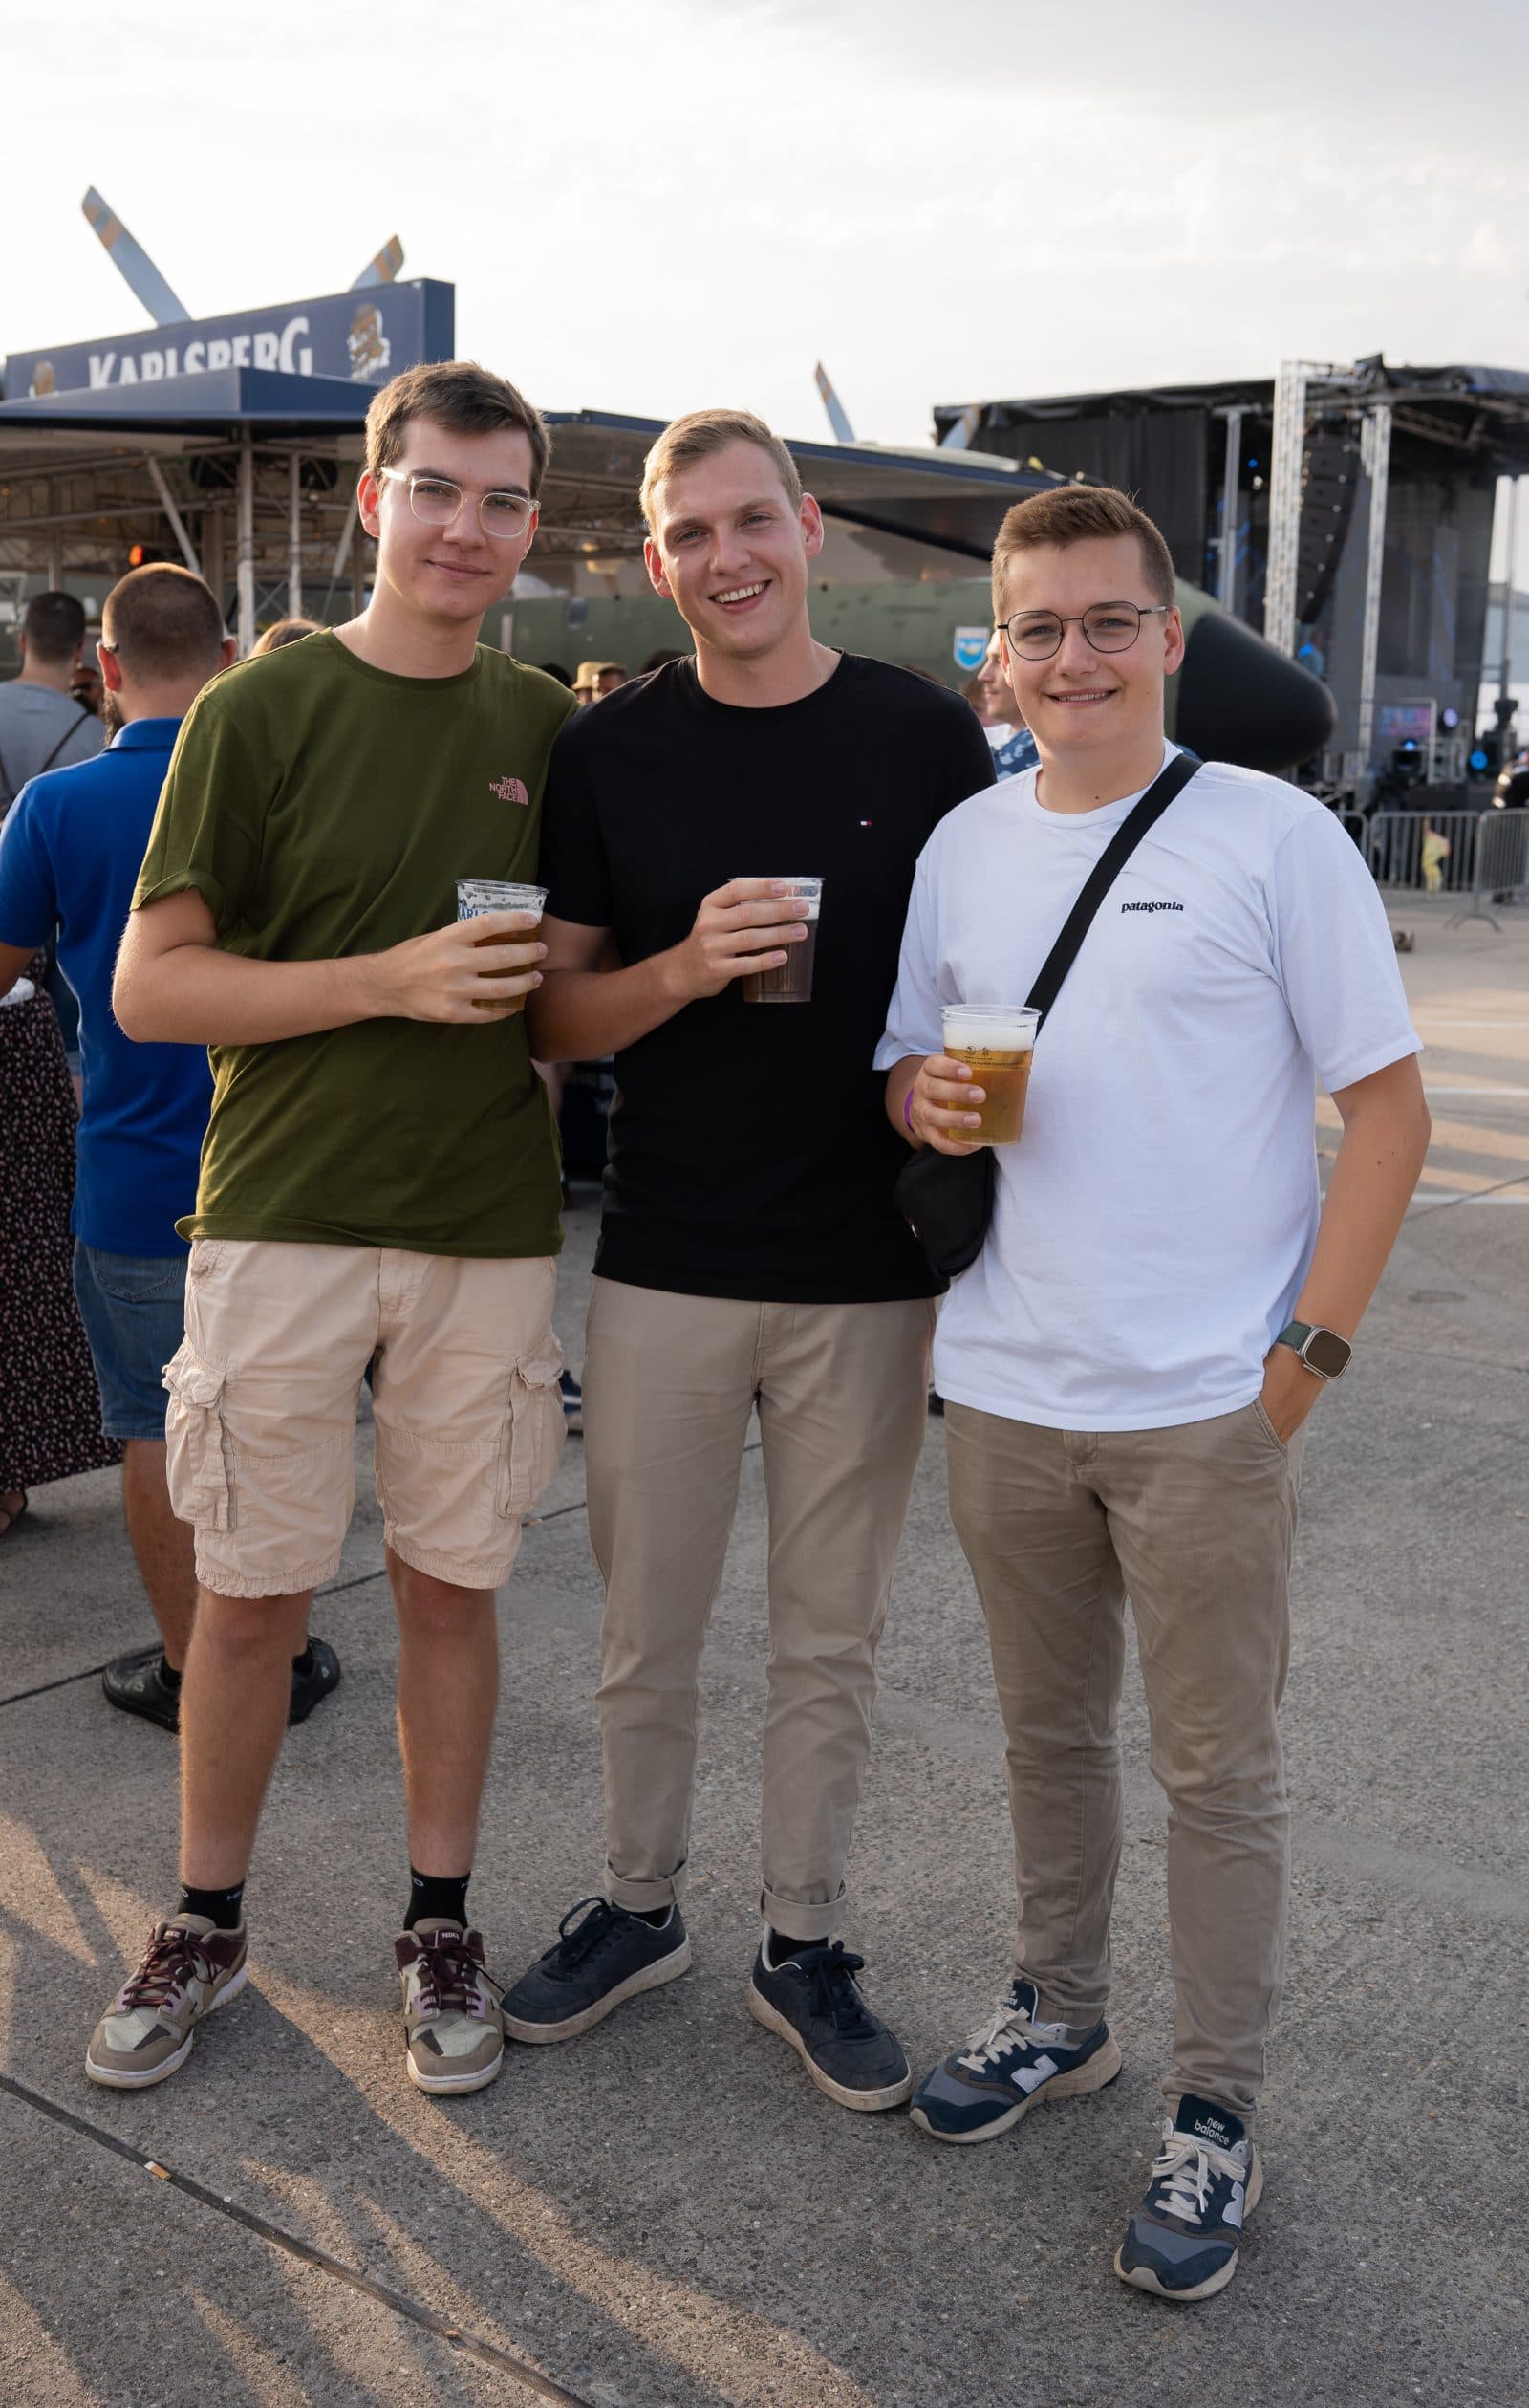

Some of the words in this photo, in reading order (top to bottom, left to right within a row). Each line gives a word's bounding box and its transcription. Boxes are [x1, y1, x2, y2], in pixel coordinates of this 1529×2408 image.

[501, 776, 517, 786] THE
[489, 782, 517, 794] NORTH
[498, 792, 518, 802] FACE
[1121, 901, 1184, 914] patagonia
[1206, 2117, 1225, 2133] new
[1194, 2118, 1230, 2145] balance
